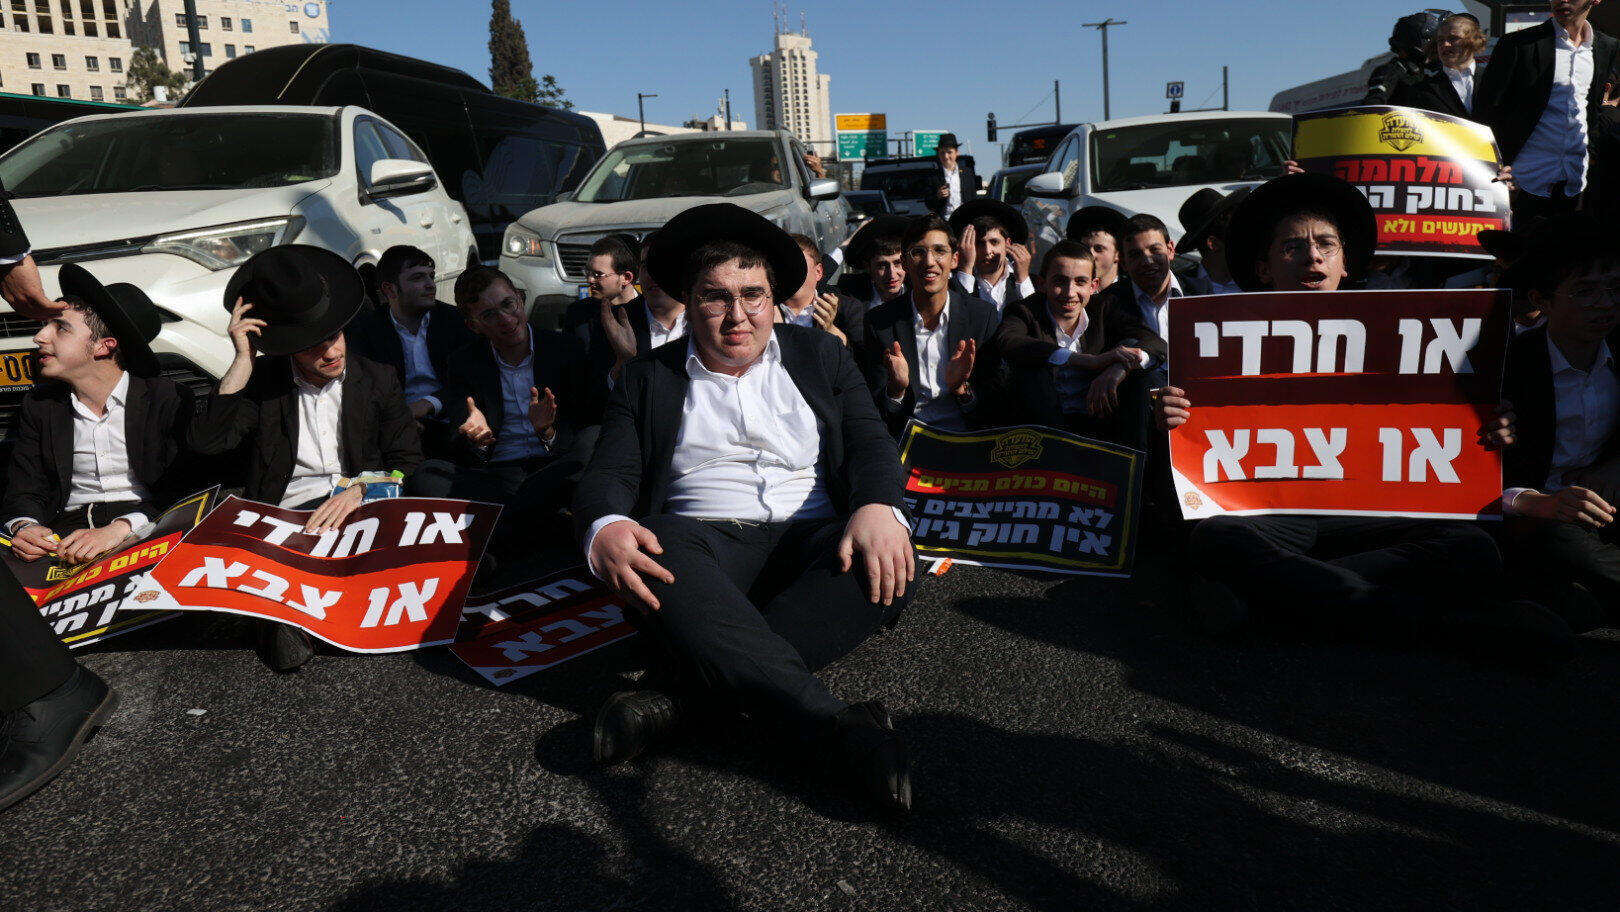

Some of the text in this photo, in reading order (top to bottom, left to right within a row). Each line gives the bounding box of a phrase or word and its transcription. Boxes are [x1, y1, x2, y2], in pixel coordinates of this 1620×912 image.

[1334, 156, 1463, 184] מלחמה
[1405, 186, 1496, 214] בחוק
[1384, 218, 1415, 233] ולא
[1194, 318, 1482, 376] או חרדי
[1203, 427, 1462, 483] או צבא
[918, 474, 1108, 500] היום כולם מבינים
[923, 499, 1061, 519] מתייצבים
[1069, 505, 1115, 529] לא
[232, 509, 475, 558] או חרדי
[911, 517, 1113, 555] אין חוק גיו
[109, 541, 170, 572] היום
[178, 557, 343, 621] צבא
[360, 577, 440, 628] או
[460, 578, 593, 622] חרד
[490, 603, 626, 662] צבא
